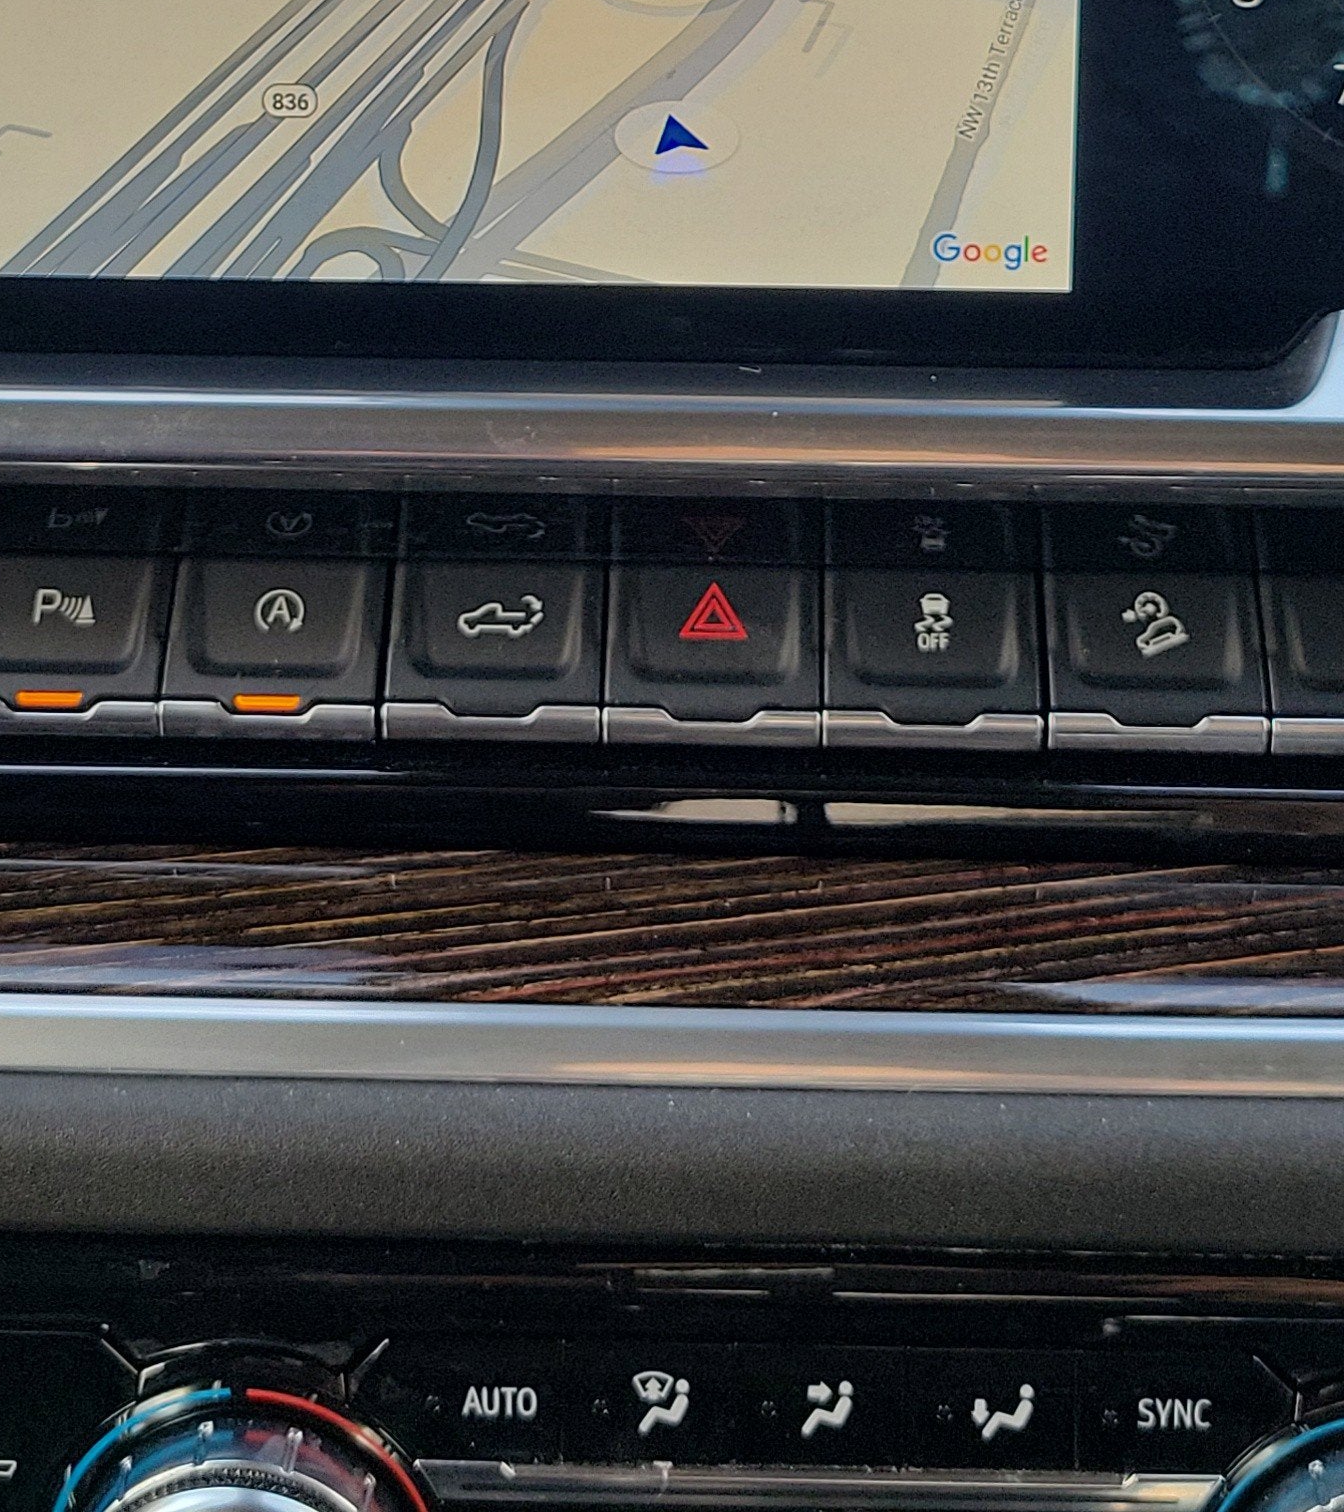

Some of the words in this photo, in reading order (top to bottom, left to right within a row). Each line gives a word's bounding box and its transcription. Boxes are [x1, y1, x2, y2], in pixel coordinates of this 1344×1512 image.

[272, 92, 309, 111] 836
[958, 105, 983, 139] NW
[973, 61, 1000, 102] 13th
[933, 233, 1049, 271] Google
[32, 588, 62, 625] P
[917, 632, 951, 653] OFF
[460, 1385, 539, 1418] AUTO
[1136, 1398, 1213, 1430] SYNC
